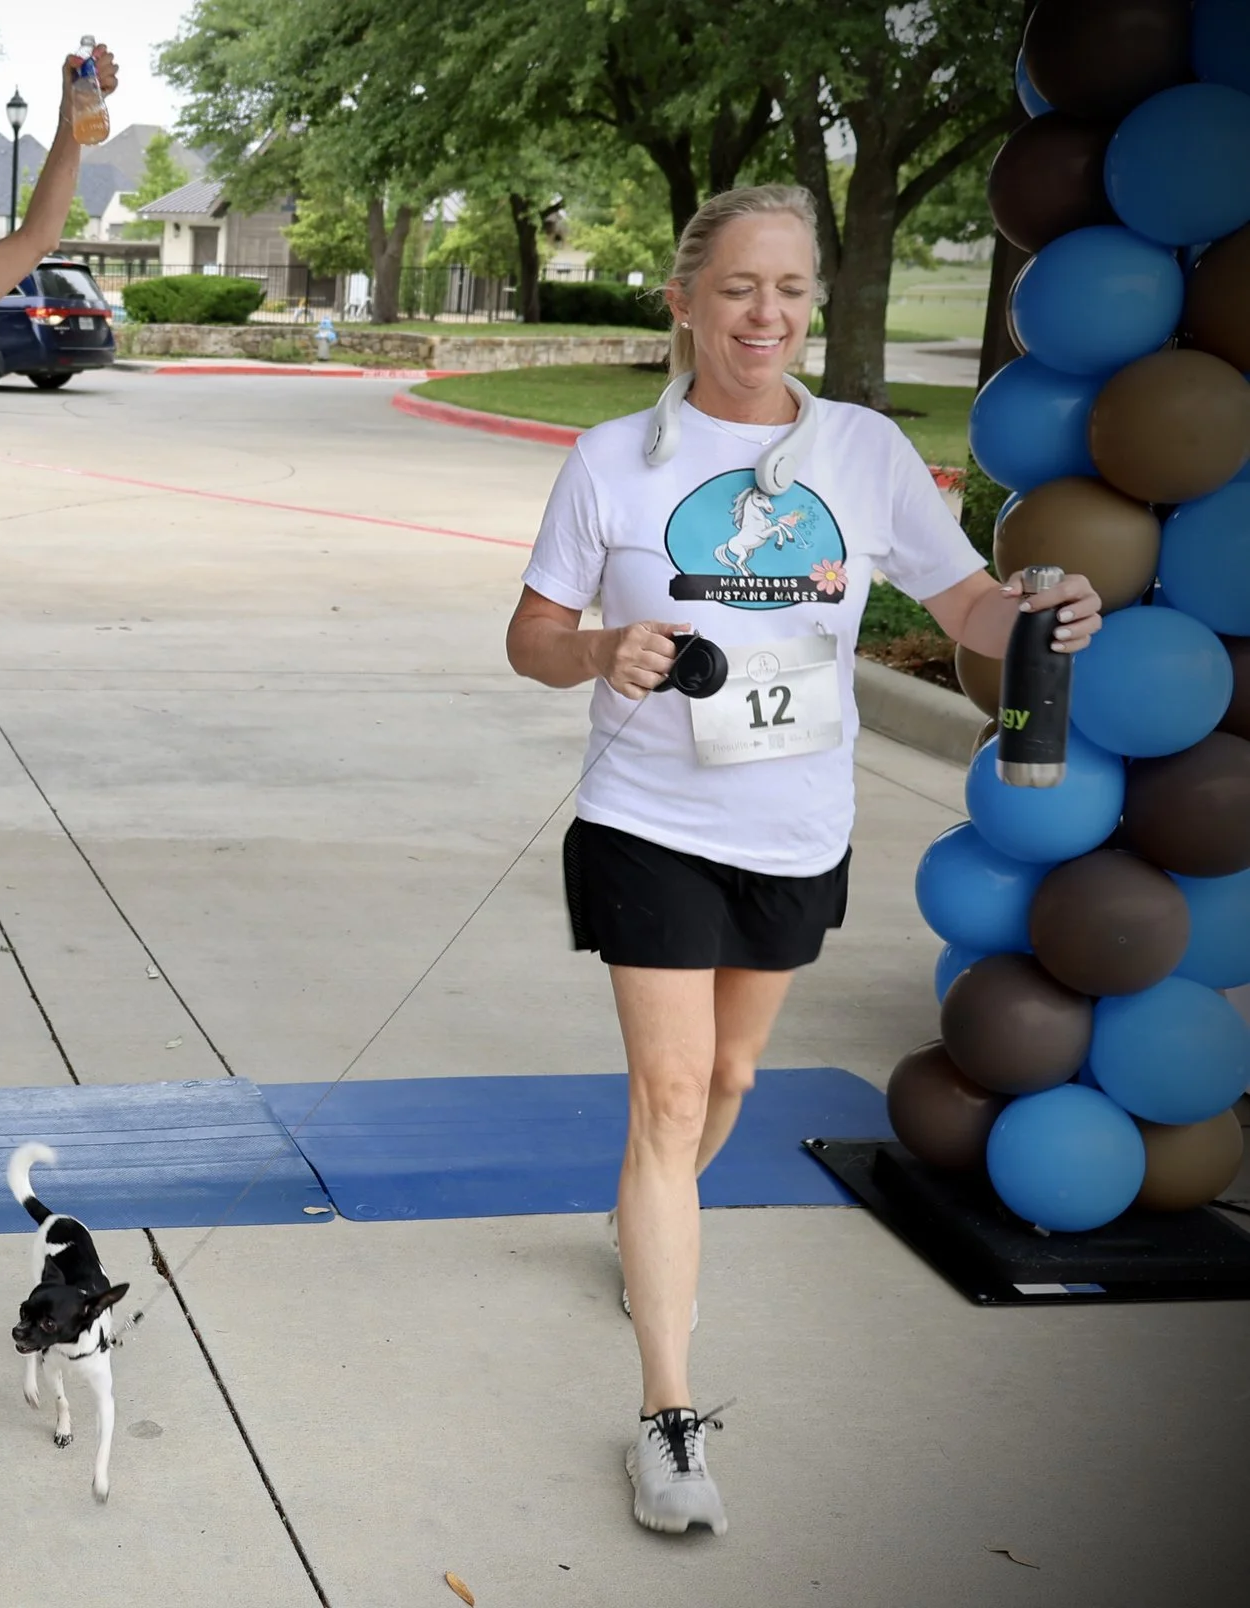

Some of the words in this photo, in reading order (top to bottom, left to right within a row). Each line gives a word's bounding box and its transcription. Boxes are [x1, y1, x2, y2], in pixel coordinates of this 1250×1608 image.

[720, 577, 798, 588] MARVELOUS
[705, 590, 768, 601] MUSTANG
[774, 591, 818, 602] MARES
[745, 685, 795, 729] 12
[999, 706, 1030, 730] gy
